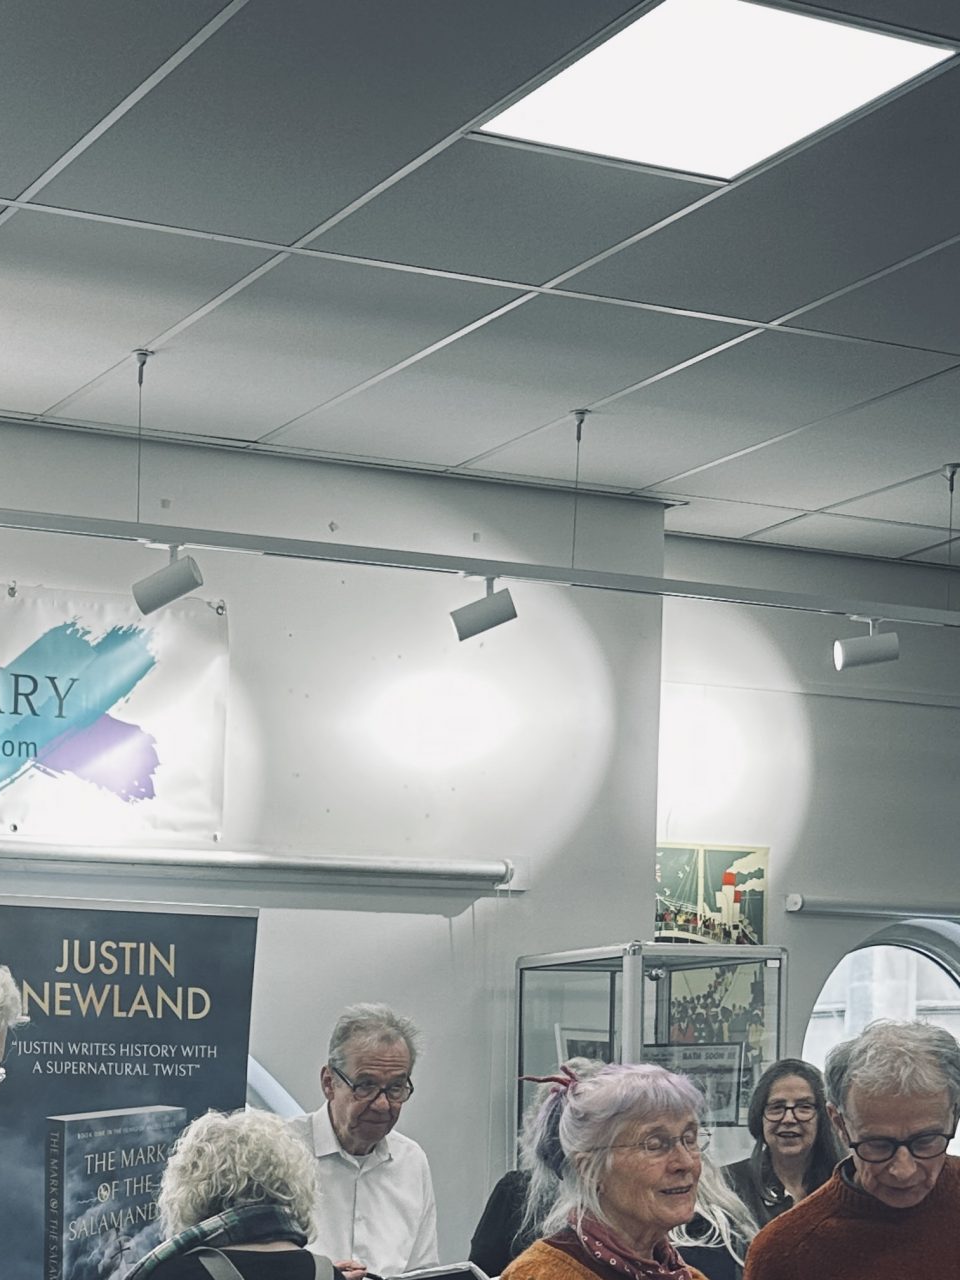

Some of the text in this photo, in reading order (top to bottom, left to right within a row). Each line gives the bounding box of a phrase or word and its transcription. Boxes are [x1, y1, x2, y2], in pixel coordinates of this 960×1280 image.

[55, 938, 176, 978] JUSTIN
[21, 978, 211, 1021] NEWLAND
[67, 1041, 117, 1057] WRITES
[119, 1043, 178, 1058] HISTORY
[180, 1045, 218, 1059] WITH
[32, 1061, 42, 1074] A
[46, 1060, 150, 1077] SUPERNATURAL
[49, 1132, 59, 1153] THE
[84, 1143, 168, 1175] THE MARK
[49, 1158, 59, 1195] MARK
[97, 1174, 153, 1203] OF THE
[68, 1201, 161, 1241] SALAMAND
